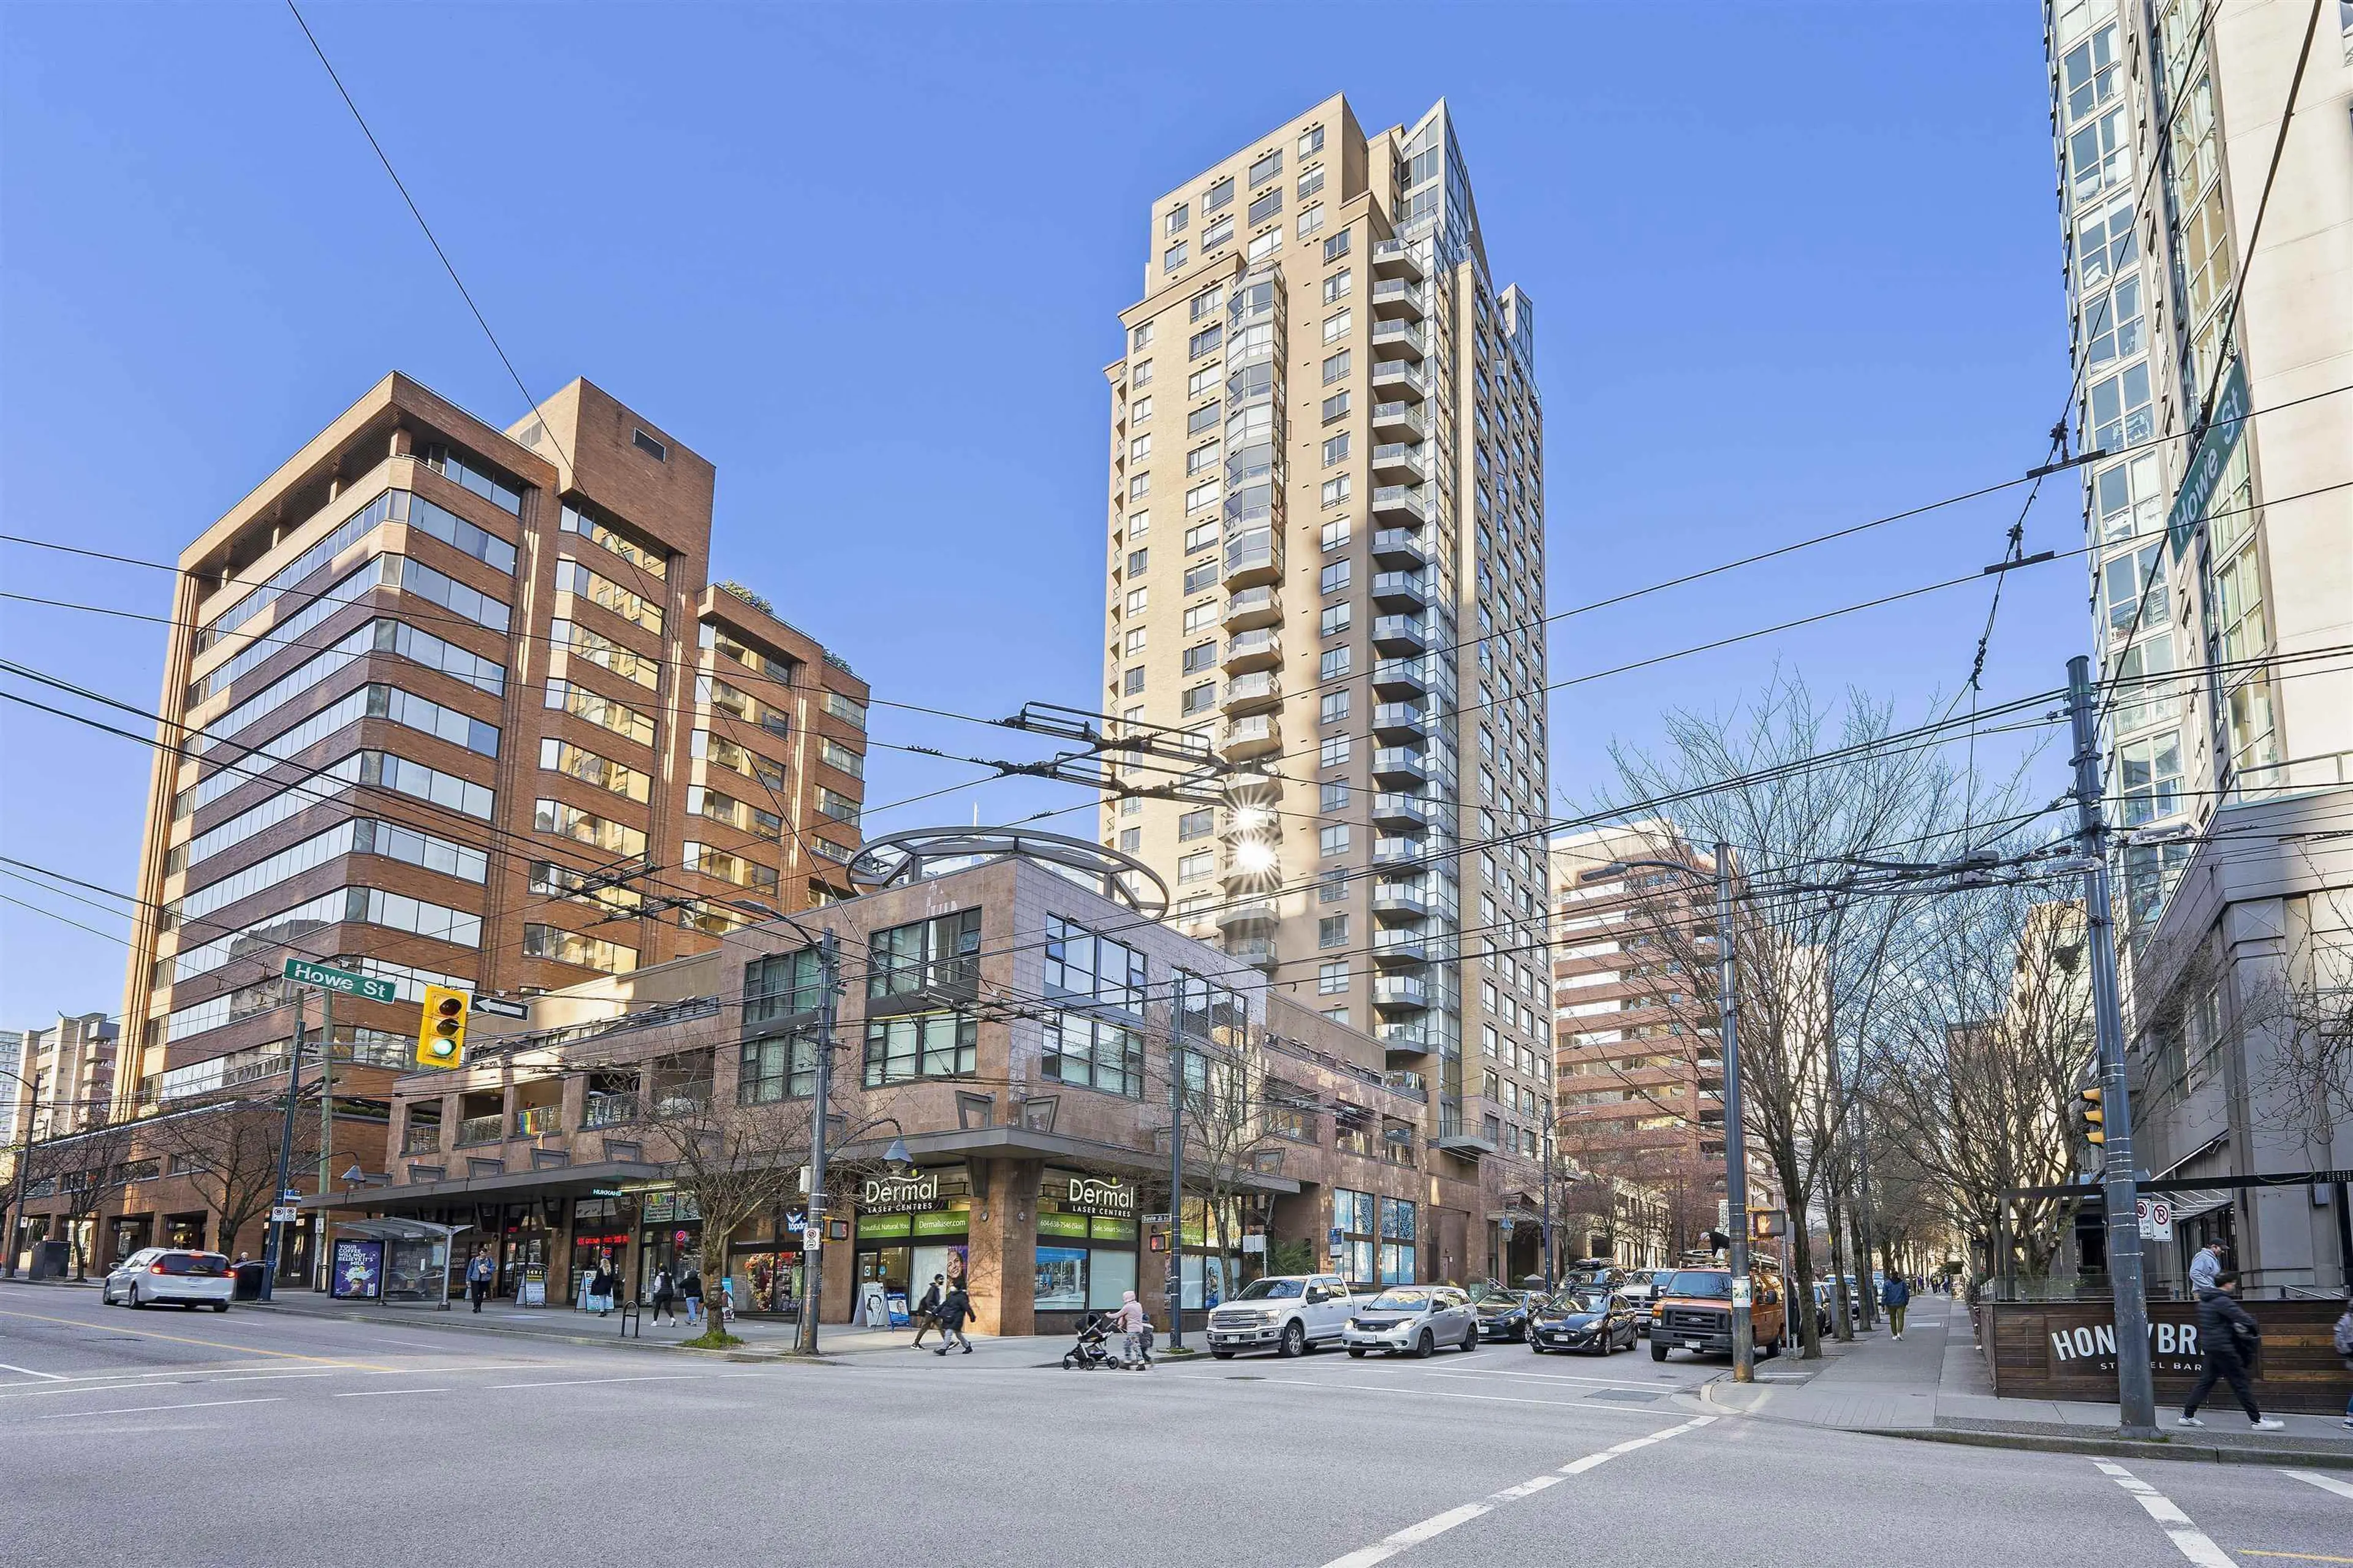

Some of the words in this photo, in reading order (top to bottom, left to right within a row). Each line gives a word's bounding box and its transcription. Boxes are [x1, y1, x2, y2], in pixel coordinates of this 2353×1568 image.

[2175, 449, 2218, 543] Howe
[2222, 387, 2241, 444] St
[294, 963, 354, 990] Howe
[363, 981, 386, 998] St
[865, 1174, 938, 1203] Dermal
[1069, 1178, 1134, 1208] Dermal
[895, 1202, 933, 1211] CENTRES
[1072, 1205, 1096, 1214] LASER
[1099, 1208, 1131, 1218] CENTRES
[788, 1221, 808, 1232] topdra
[2051, 1323, 2205, 1362] HONBR
[2100, 1362, 2165, 1370] STEL
[2173, 1363, 2202, 1371] BAR
